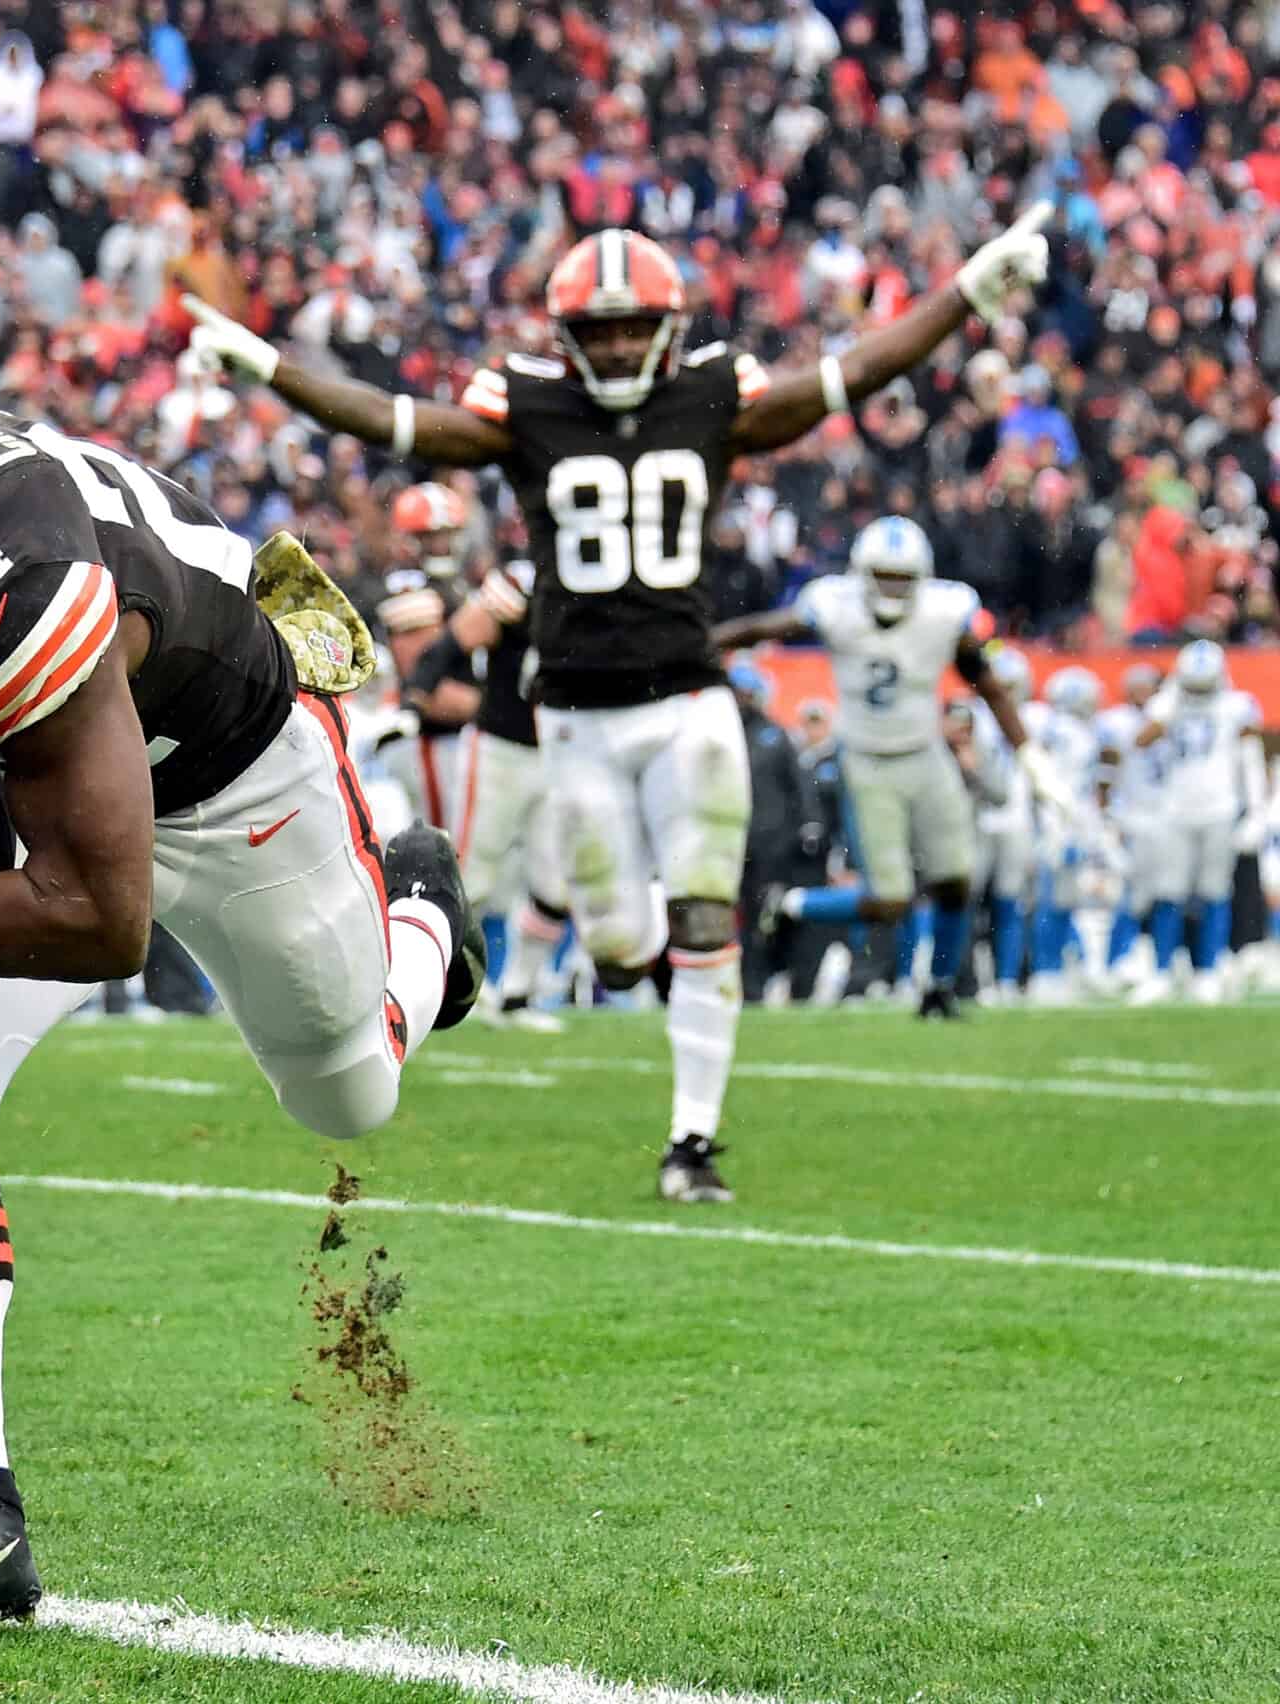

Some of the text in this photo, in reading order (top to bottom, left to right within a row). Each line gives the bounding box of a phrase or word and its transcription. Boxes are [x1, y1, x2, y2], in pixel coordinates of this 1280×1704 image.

[22, 422, 254, 596] 2
[547, 449, 708, 593] 80
[865, 661, 898, 710] 2
